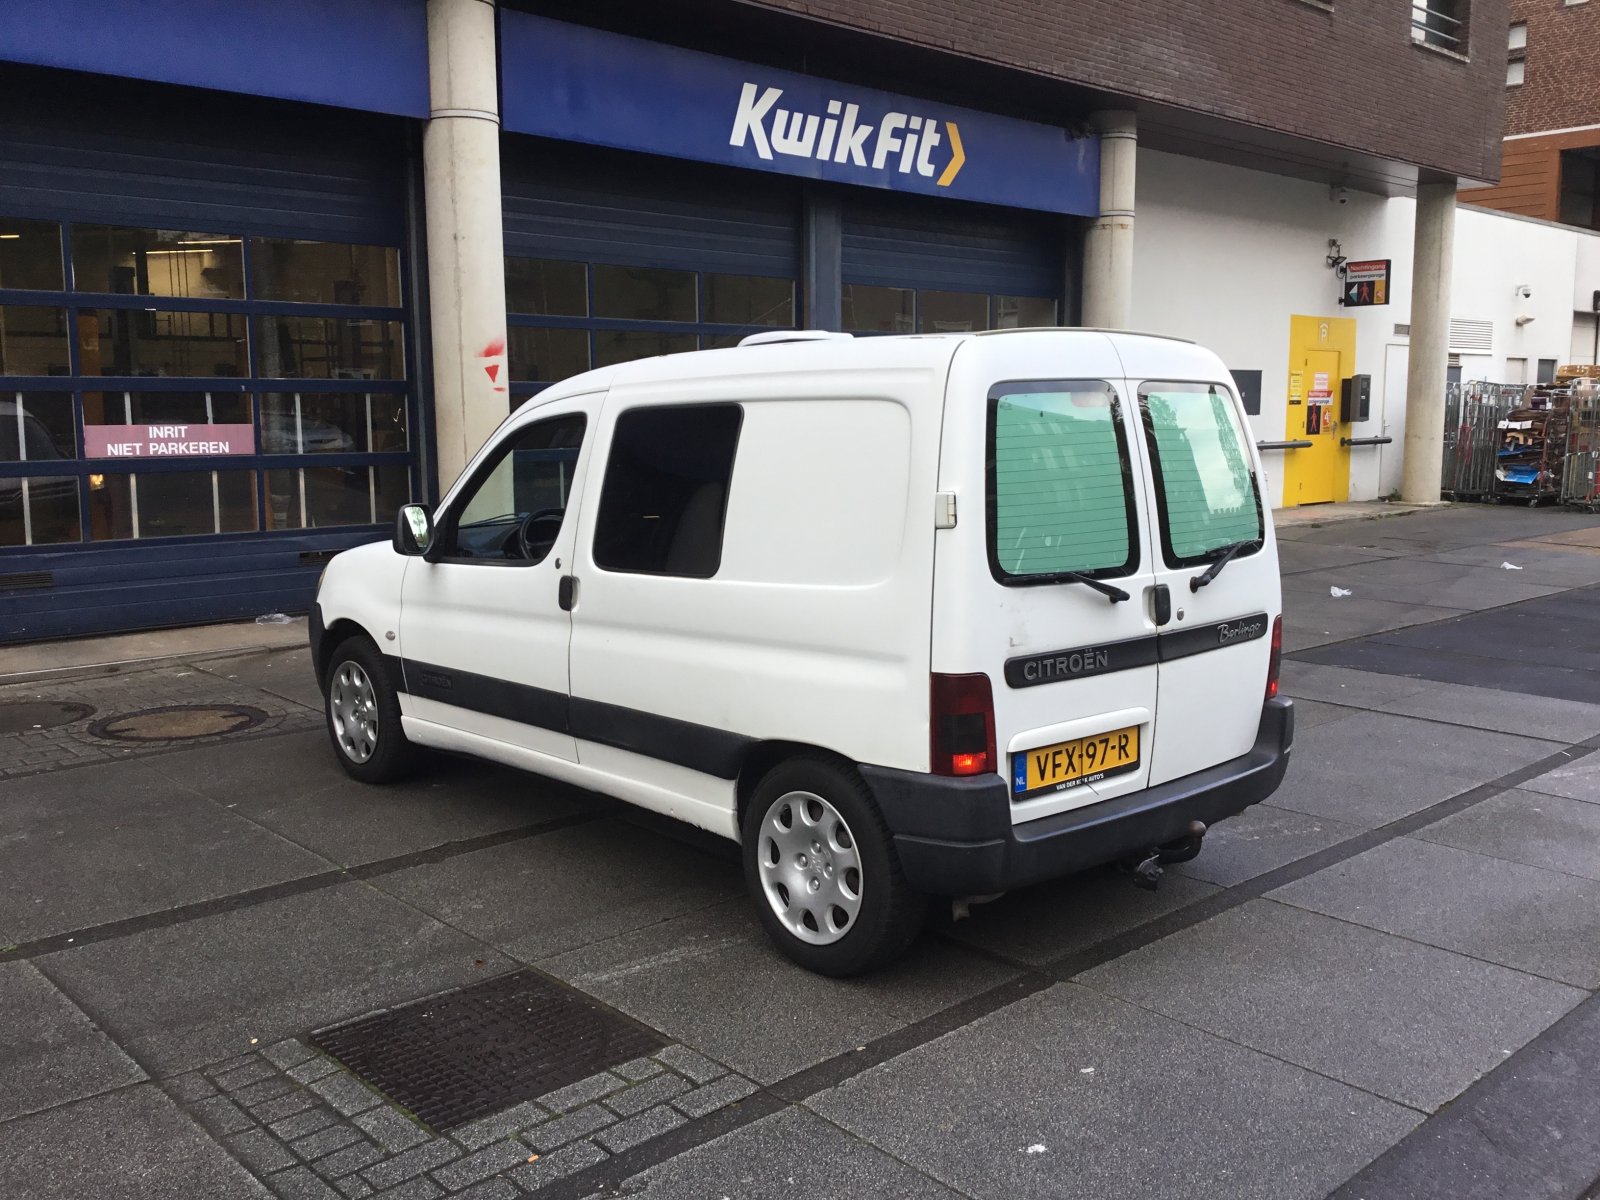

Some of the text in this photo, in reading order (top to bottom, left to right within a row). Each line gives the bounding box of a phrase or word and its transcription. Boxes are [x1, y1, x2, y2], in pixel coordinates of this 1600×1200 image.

[149, 425, 188, 439] INRIT
[107, 441, 230, 456] NIET PARKEREN
[1217, 620, 1262, 644] Berlingo
[1023, 648, 1109, 681] CITROËN
[1036, 733, 1130, 781] VFX-97-R
[1015, 776, 1026, 787] NL
[1056, 783, 1066, 791] VAN
[1066, 780, 1076, 788] DER
